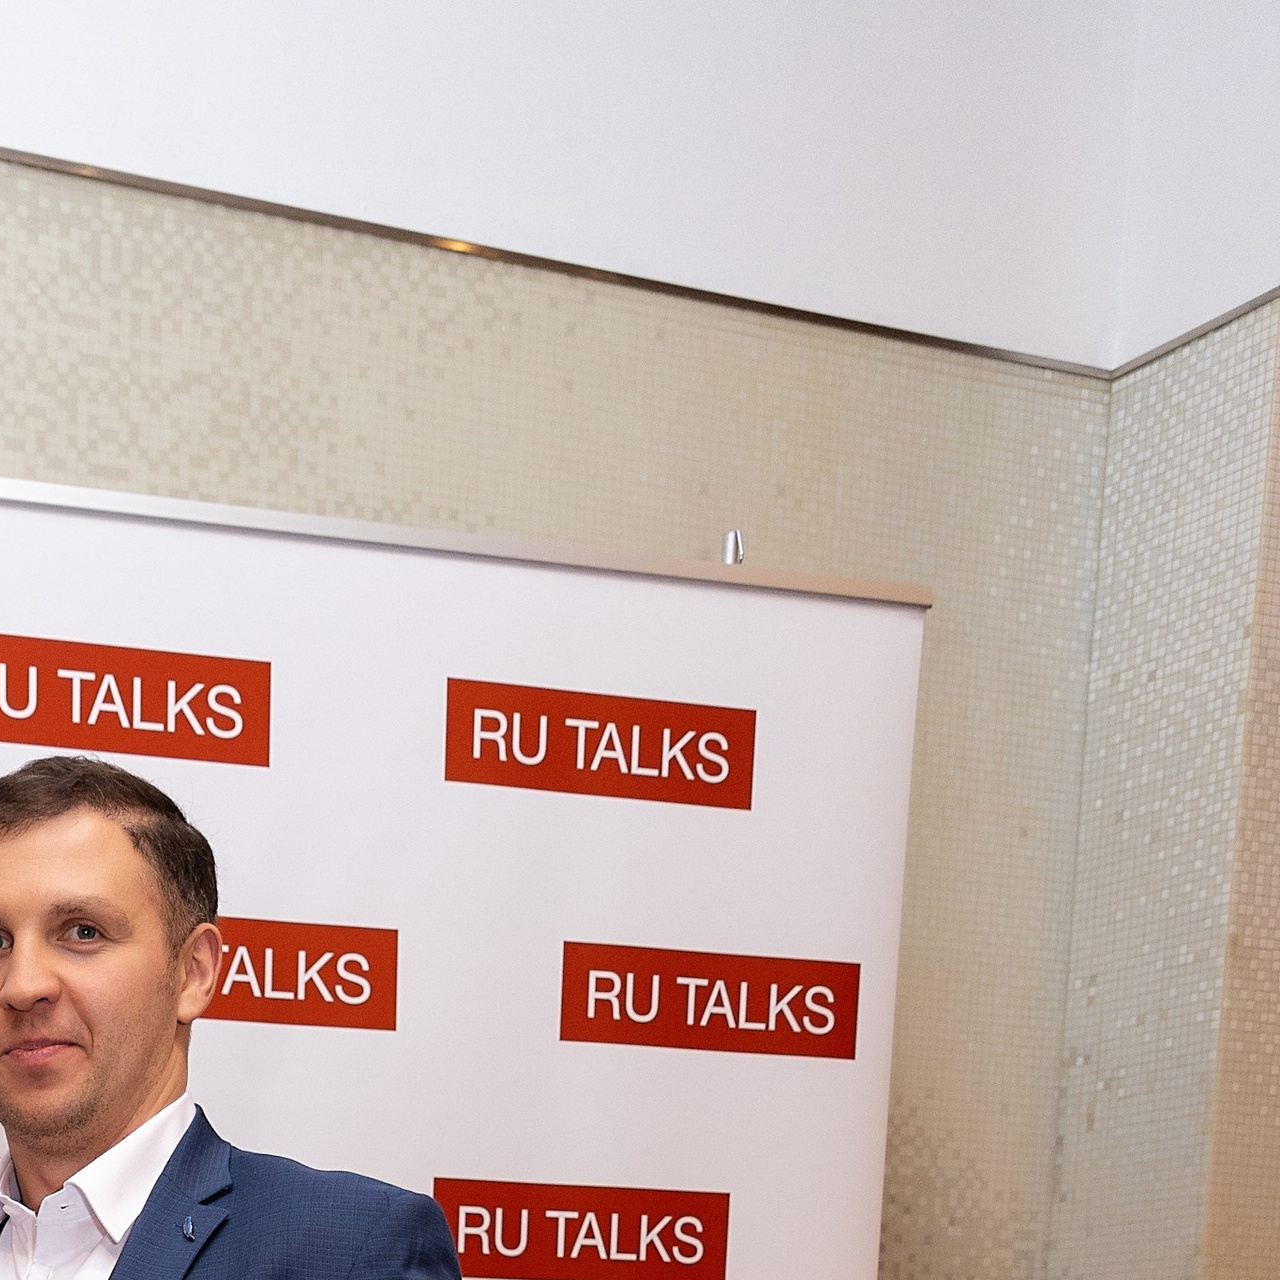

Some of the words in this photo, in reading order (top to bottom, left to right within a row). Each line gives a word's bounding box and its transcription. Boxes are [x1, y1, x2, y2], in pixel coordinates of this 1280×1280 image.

[56, 668, 244, 739] TALKS
[472, 708, 548, 766] RU
[564, 717, 730, 784] TALKS
[221, 944, 372, 1006] ALKS
[587, 969, 660, 1023] RU
[676, 976, 835, 1035] TALKS
[457, 1205, 529, 1257] RU
[545, 1210, 704, 1265] TALKS
